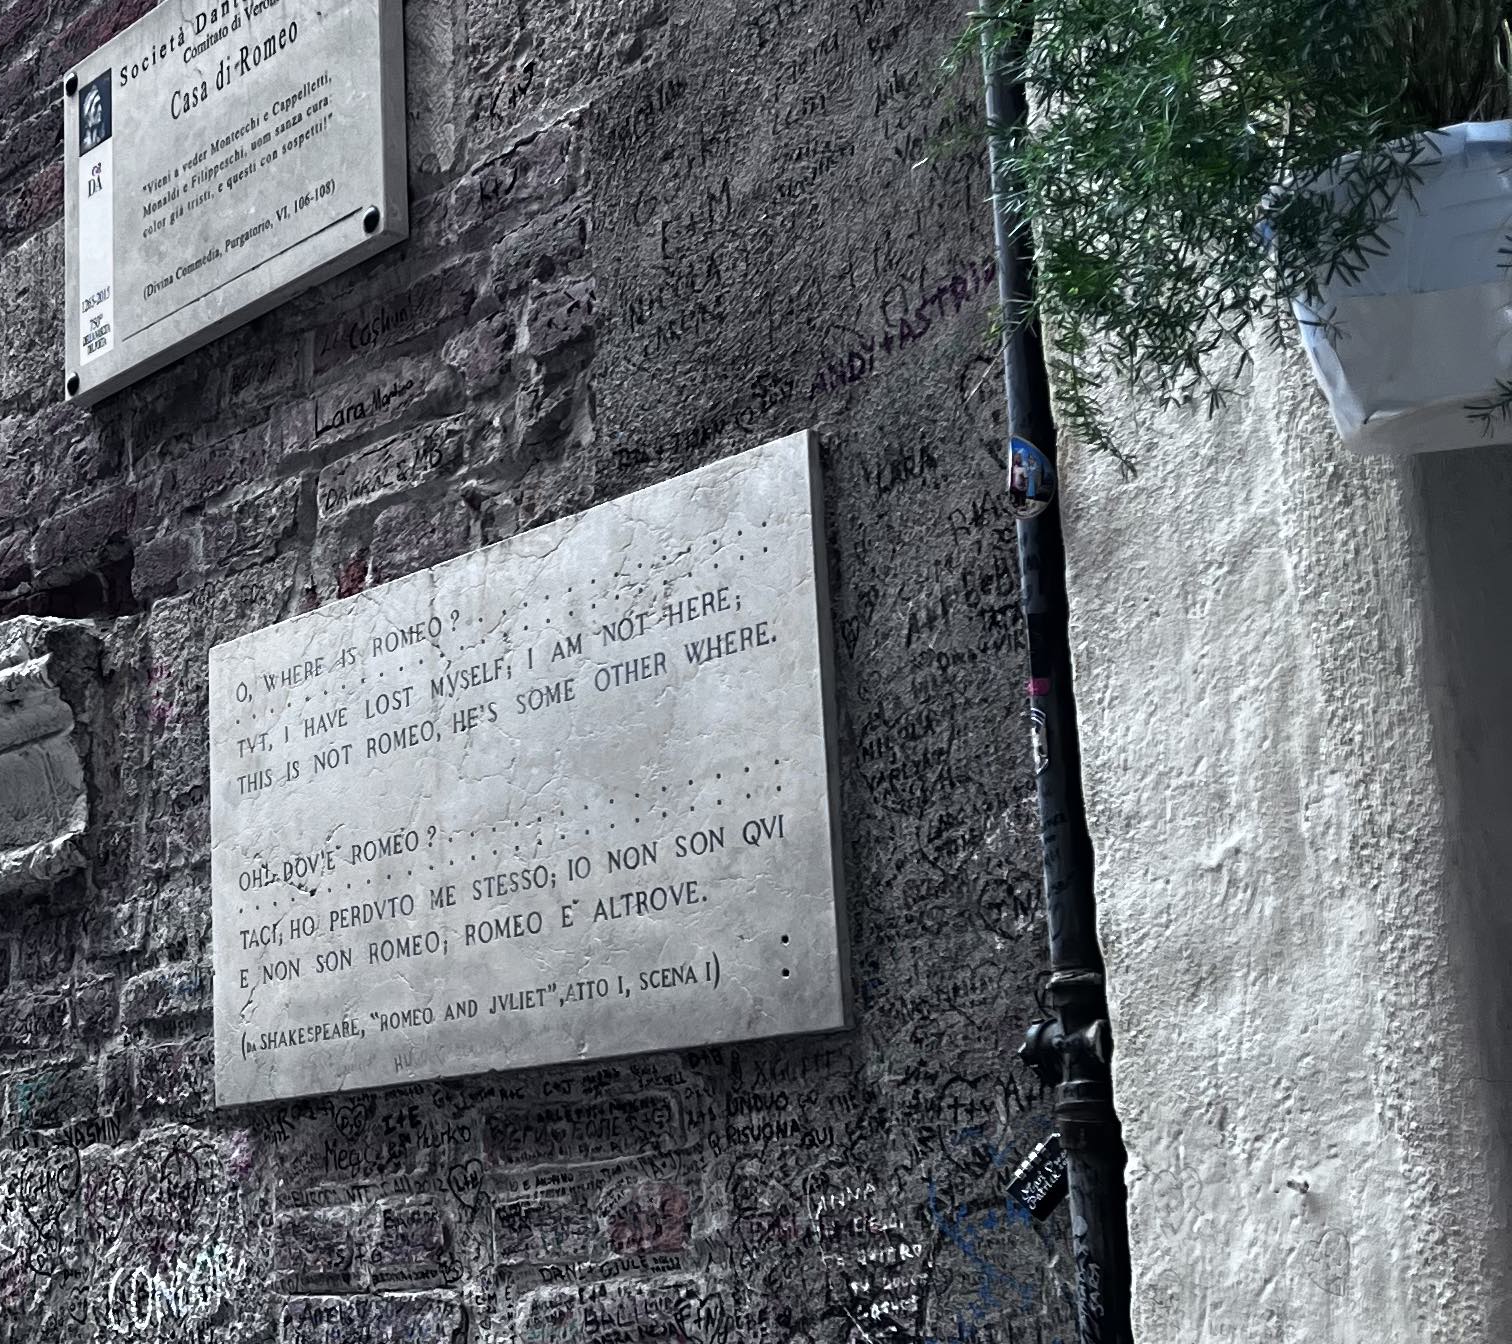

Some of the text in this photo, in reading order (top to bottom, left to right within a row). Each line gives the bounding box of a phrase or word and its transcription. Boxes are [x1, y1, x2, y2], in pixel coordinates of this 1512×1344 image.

[119, 25, 184, 89] Società
[170, 20, 298, 122] Casa di Romeo
[183, 24, 228, 66] Comitato
[230, 11, 241, 33] di
[142, 186, 180, 219] Monaldi
[274, 111, 303, 138] sanza
[142, 216, 165, 239] color
[226, 161, 257, 192] questi
[259, 148, 278, 168] con
[181, 148, 208, 174] veder
[209, 116, 260, 157] Montecchi
[143, 273, 173, 302] (Divina
[175, 247, 222, 281] Commedia,
[224, 218, 273, 254] Purgatorio,
[294, 177, 336, 215] 106-108)
[235, 680, 253, 704] O,
[262, 655, 325, 694] WHERE
[340, 645, 357, 669] IS
[236, 767, 273, 796] THIS
[285, 759, 300, 782] IS
[313, 743, 353, 774] NOT
[366, 717, 442, 760] ROMEO,
[516, 676, 576, 716] SOME
[593, 650, 667, 694] OTHER
[684, 619, 777, 666] WHERE.
[283, 724, 289, 744] I
[303, 706, 348, 738] HAVE
[365, 685, 414, 720] LOST
[527, 647, 533, 670] I
[550, 631, 582, 663] AM
[601, 611, 649, 647] NOT
[668, 585, 742, 628] HERE;
[289, 915, 315, 940] HO
[429, 884, 457, 911] ME
[472, 863, 557, 902] STESSO;
[567, 854, 592, 883] IO
[607, 840, 658, 874] NON
[674, 825, 726, 859] SON
[239, 968, 249, 989] E
[262, 957, 300, 985] NON
[315, 947, 353, 975] SON
[368, 929, 448, 966] ROMEO;
[464, 910, 543, 947] ROMEO
[592, 879, 708, 923] ALTROVE.
[259, 1018, 366, 1052] SHAKESPEARE,
[443, 998, 478, 1022] AND
[564, 977, 609, 1003] ATTO
[617, 974, 632, 999] I,
[638, 964, 696, 992] SCENA
[704, 951, 721, 991] I)
